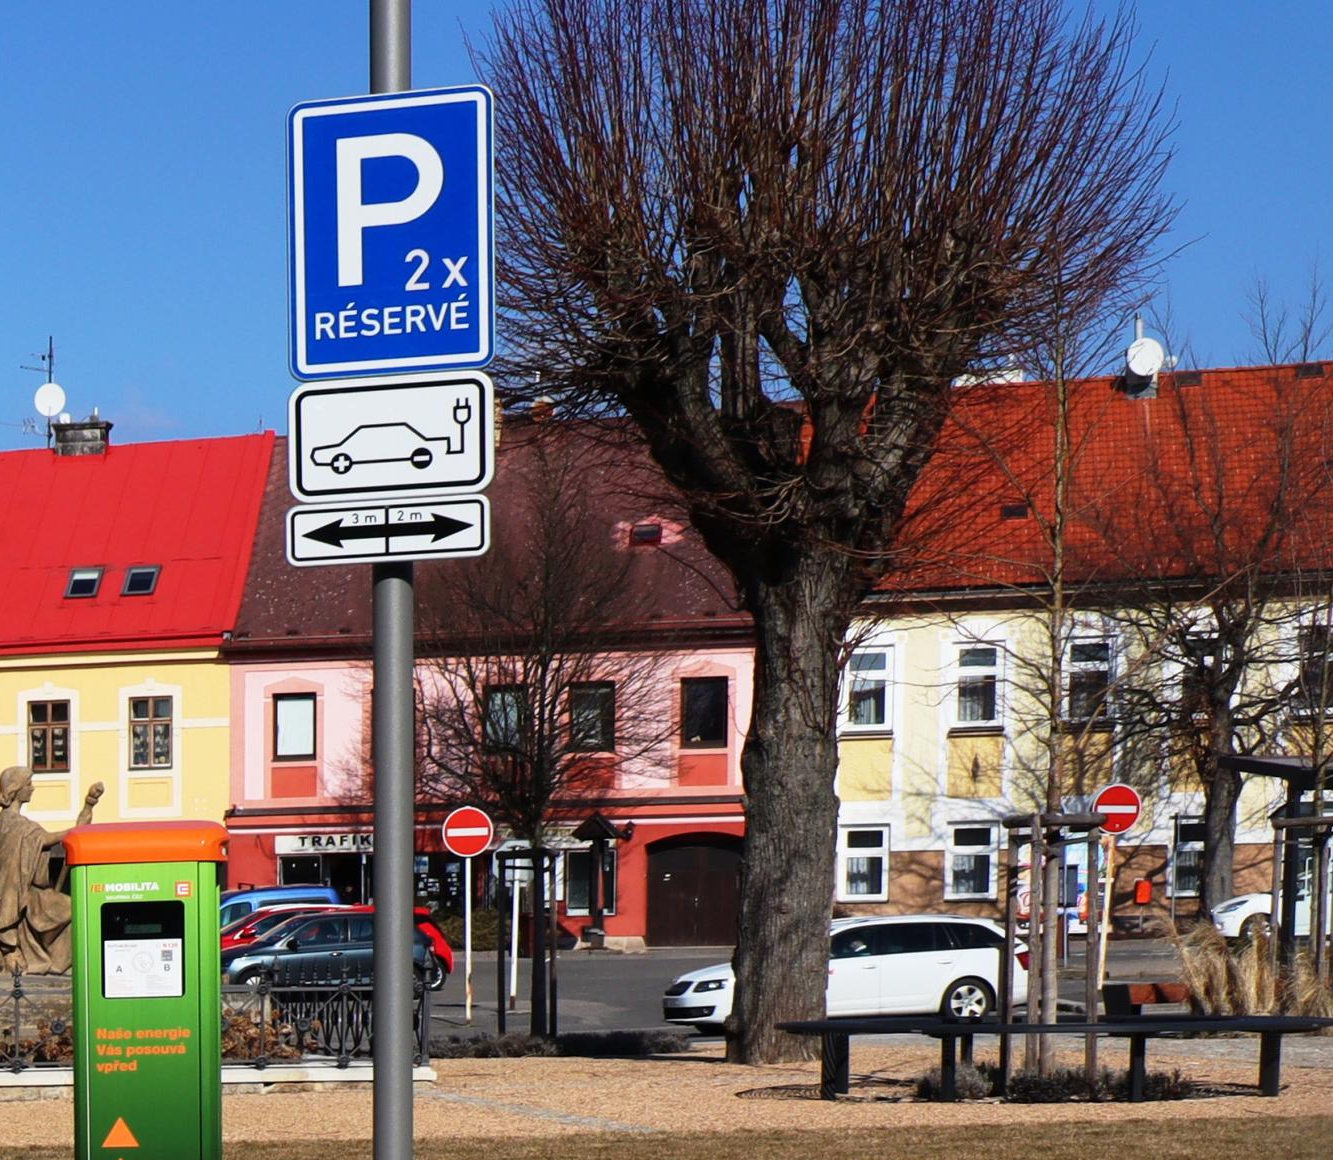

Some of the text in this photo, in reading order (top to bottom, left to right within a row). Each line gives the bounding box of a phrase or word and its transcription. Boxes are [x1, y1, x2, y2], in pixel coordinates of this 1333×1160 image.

[336, 132, 444, 287] P
[404, 248, 469, 291] 2 x
[315, 293, 470, 340] RÉSERVÉ
[352, 513, 377, 524] 3 m
[397, 511, 422, 521] 2 m
[115, 964, 123, 973] A
[163, 963, 171, 972] B
[96, 1026, 191, 1041] Naše energie
[96, 1042, 186, 1058] Vás posouvá
[96, 1059, 138, 1075] vpřed
